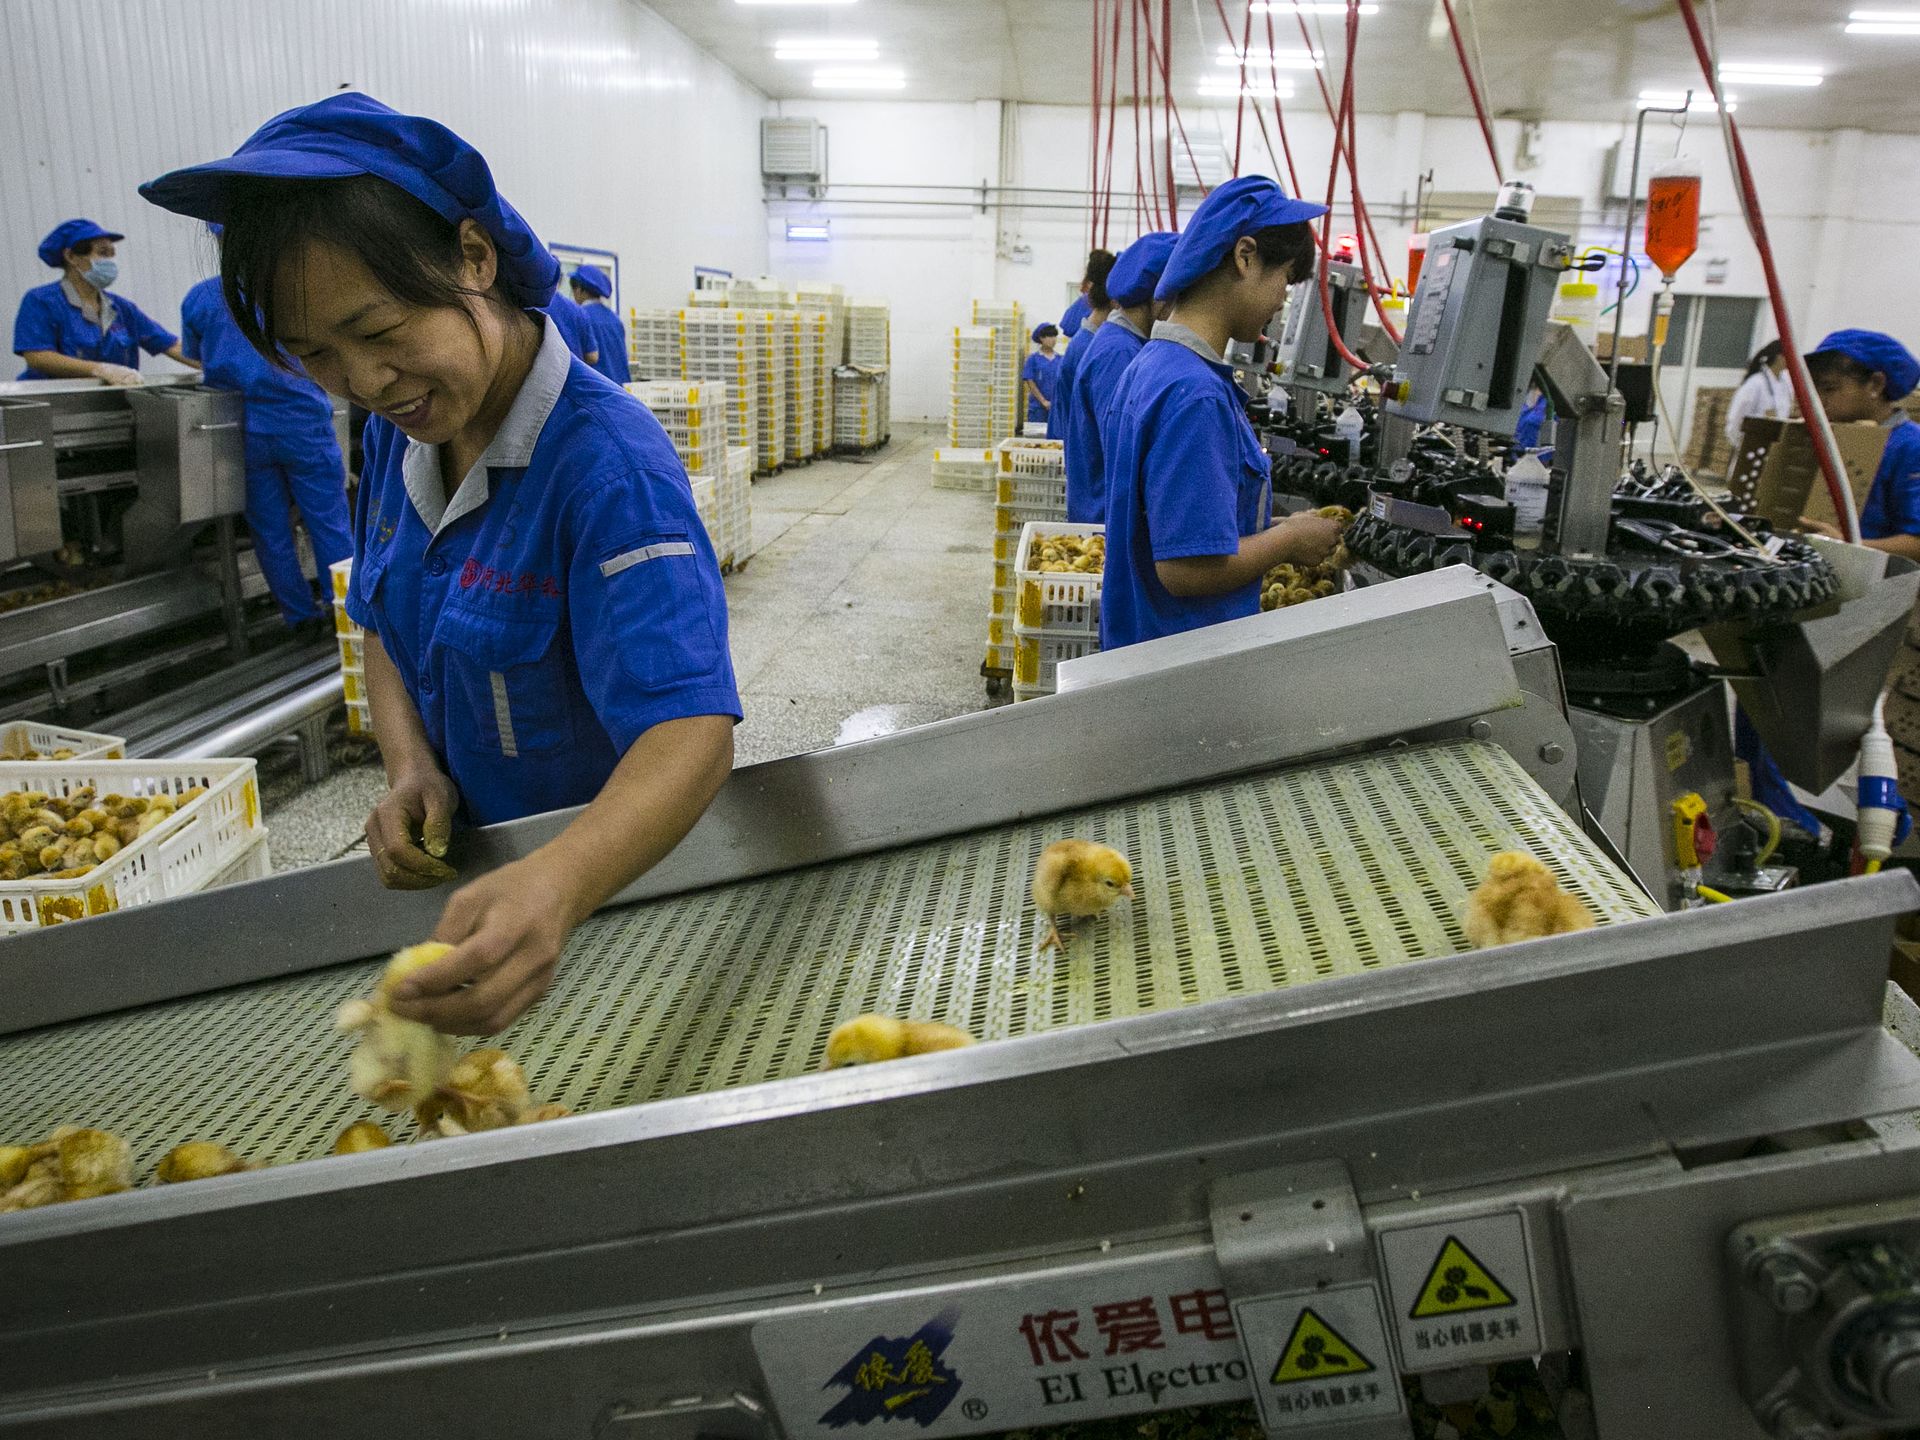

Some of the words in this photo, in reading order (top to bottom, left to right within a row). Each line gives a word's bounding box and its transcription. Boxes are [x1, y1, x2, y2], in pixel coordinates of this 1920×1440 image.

[1019, 1288, 1238, 1366] 依爱电
[1415, 1317, 1521, 1350] 当心机器夹手
[1036, 1371, 1087, 1406] EI
[1101, 1359, 1248, 1399] Electro
[1277, 1382, 1379, 1413] 当心机器夹手
